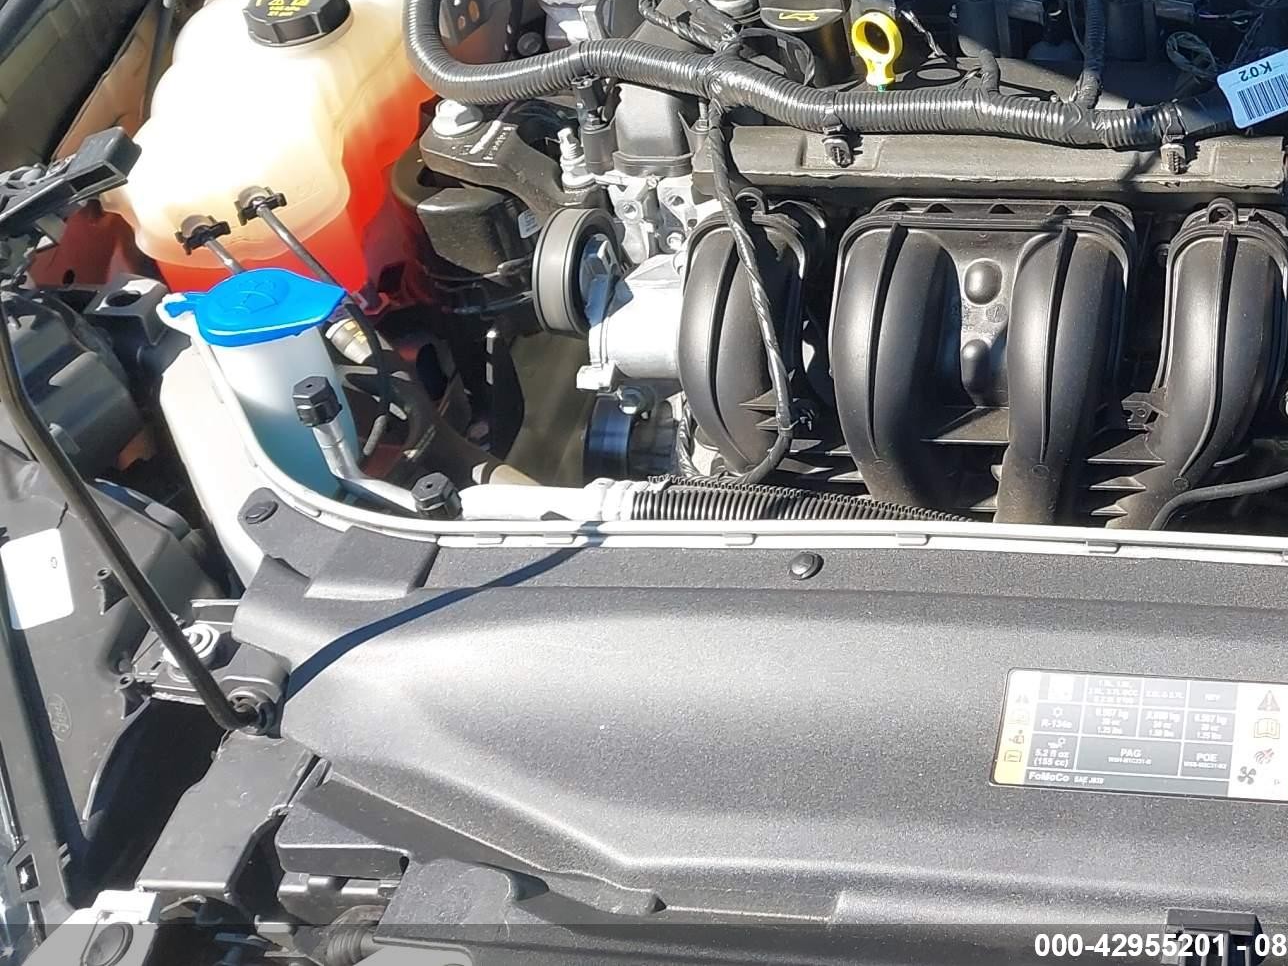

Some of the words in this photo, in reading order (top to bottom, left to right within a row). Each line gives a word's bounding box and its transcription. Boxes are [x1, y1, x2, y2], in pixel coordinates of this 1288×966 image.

[1239, 61, 1272, 82] K02
[1034, 748, 1048, 757] 5.2
[1120, 748, 1142, 757] PAG
[1196, 752, 1218, 762] POE
[1054, 759, 1069, 768] cc)
[1028, 771, 1070, 782] FoMoCo
[1073, 775, 1088, 783] SAE
